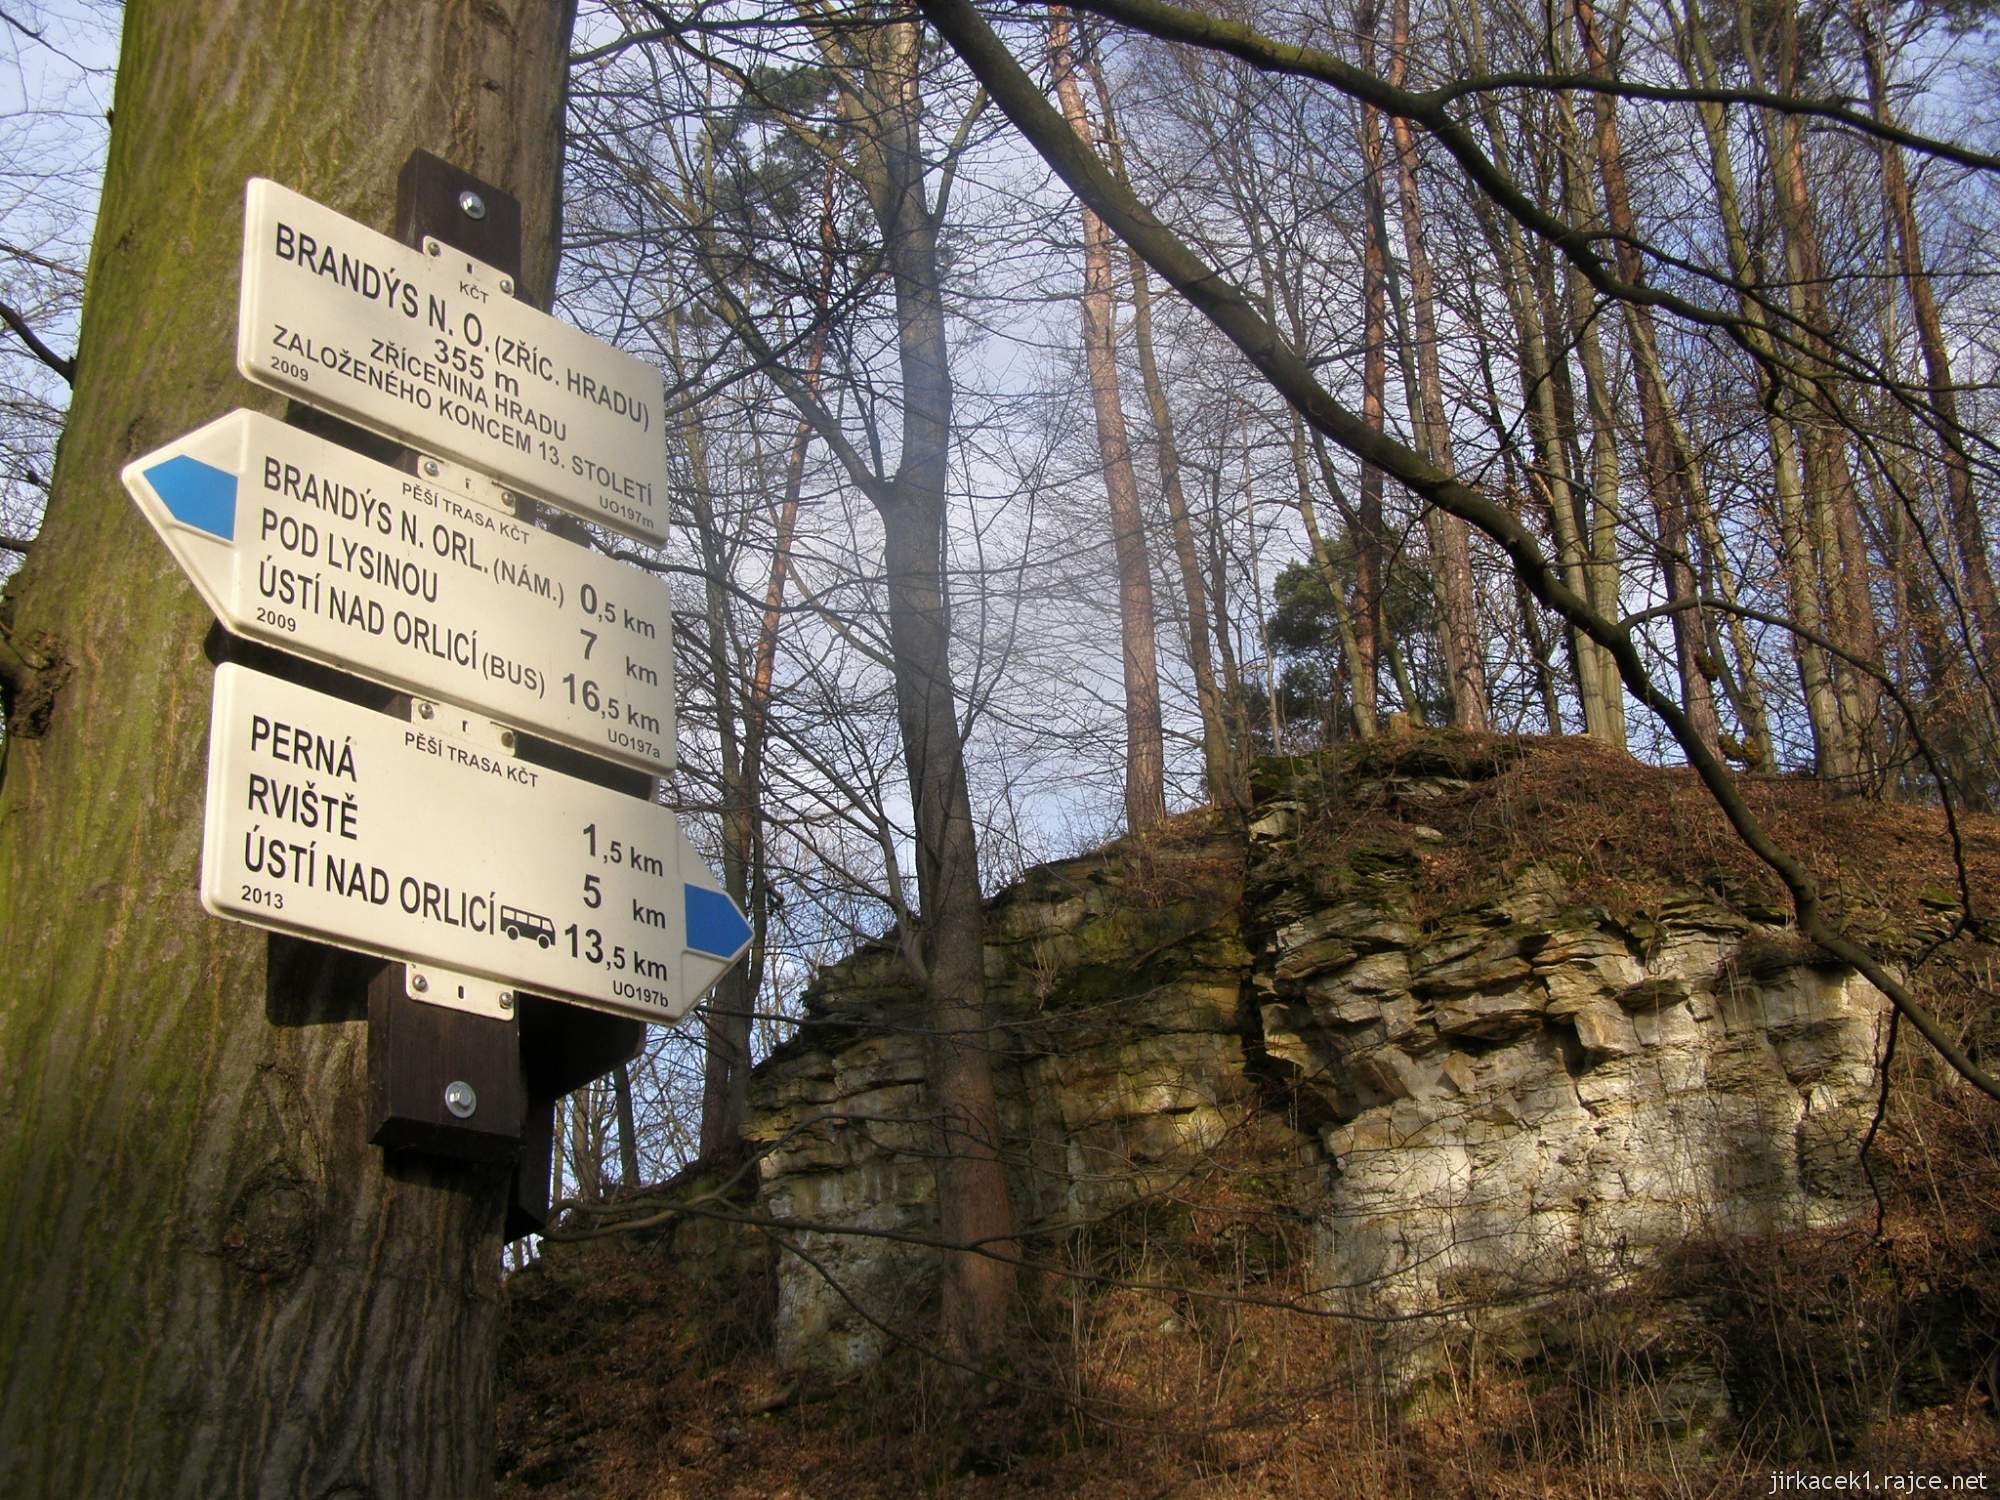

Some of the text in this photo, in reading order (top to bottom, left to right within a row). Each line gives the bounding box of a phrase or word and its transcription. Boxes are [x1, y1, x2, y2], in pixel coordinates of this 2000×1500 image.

[459, 281, 489, 304] KČT
[275, 222, 649, 431] BRANDÝS N. O. (ZŘÍC. HRADU)
[270, 356, 310, 382] 2009
[370, 338, 566, 441] ZŘÍCENINA HRADU
[434, 338, 519, 397] 355 m
[273, 324, 653, 506] ZALOŽENÉHO KONCEM 13. STOLETÍ
[263, 456, 565, 608] BRANDÝS N. ORL. (NÁM.)
[402, 482, 530, 544] PĚŠÍ TRASA KČT
[599, 496, 654, 529] UO197m
[261, 508, 439, 603] POD LYSINOU
[256, 607, 297, 633] 2009
[258, 555, 545, 699] ÚSTÍ NAD ORLICÍ (BUS)
[580, 583, 656, 639] 0,5 km
[580, 629, 658, 687] 7 km
[562, 672, 660, 735] 16,5 km
[251, 715, 357, 782] PERNÁ
[404, 731, 539, 787] PĚŠÍ TRASA KČT
[607, 728, 661, 759] UO197a
[248, 773, 358, 840] RVIŠTĚ
[582, 823, 664, 876] 1,5 km
[241, 885, 284, 910] 2013
[244, 825, 496, 936] ÚSTÍ NAD ORLICÍ
[584, 874, 666, 930] 5 km
[564, 923, 668, 982] 13,5 km
[612, 980, 669, 1008] UO197b
